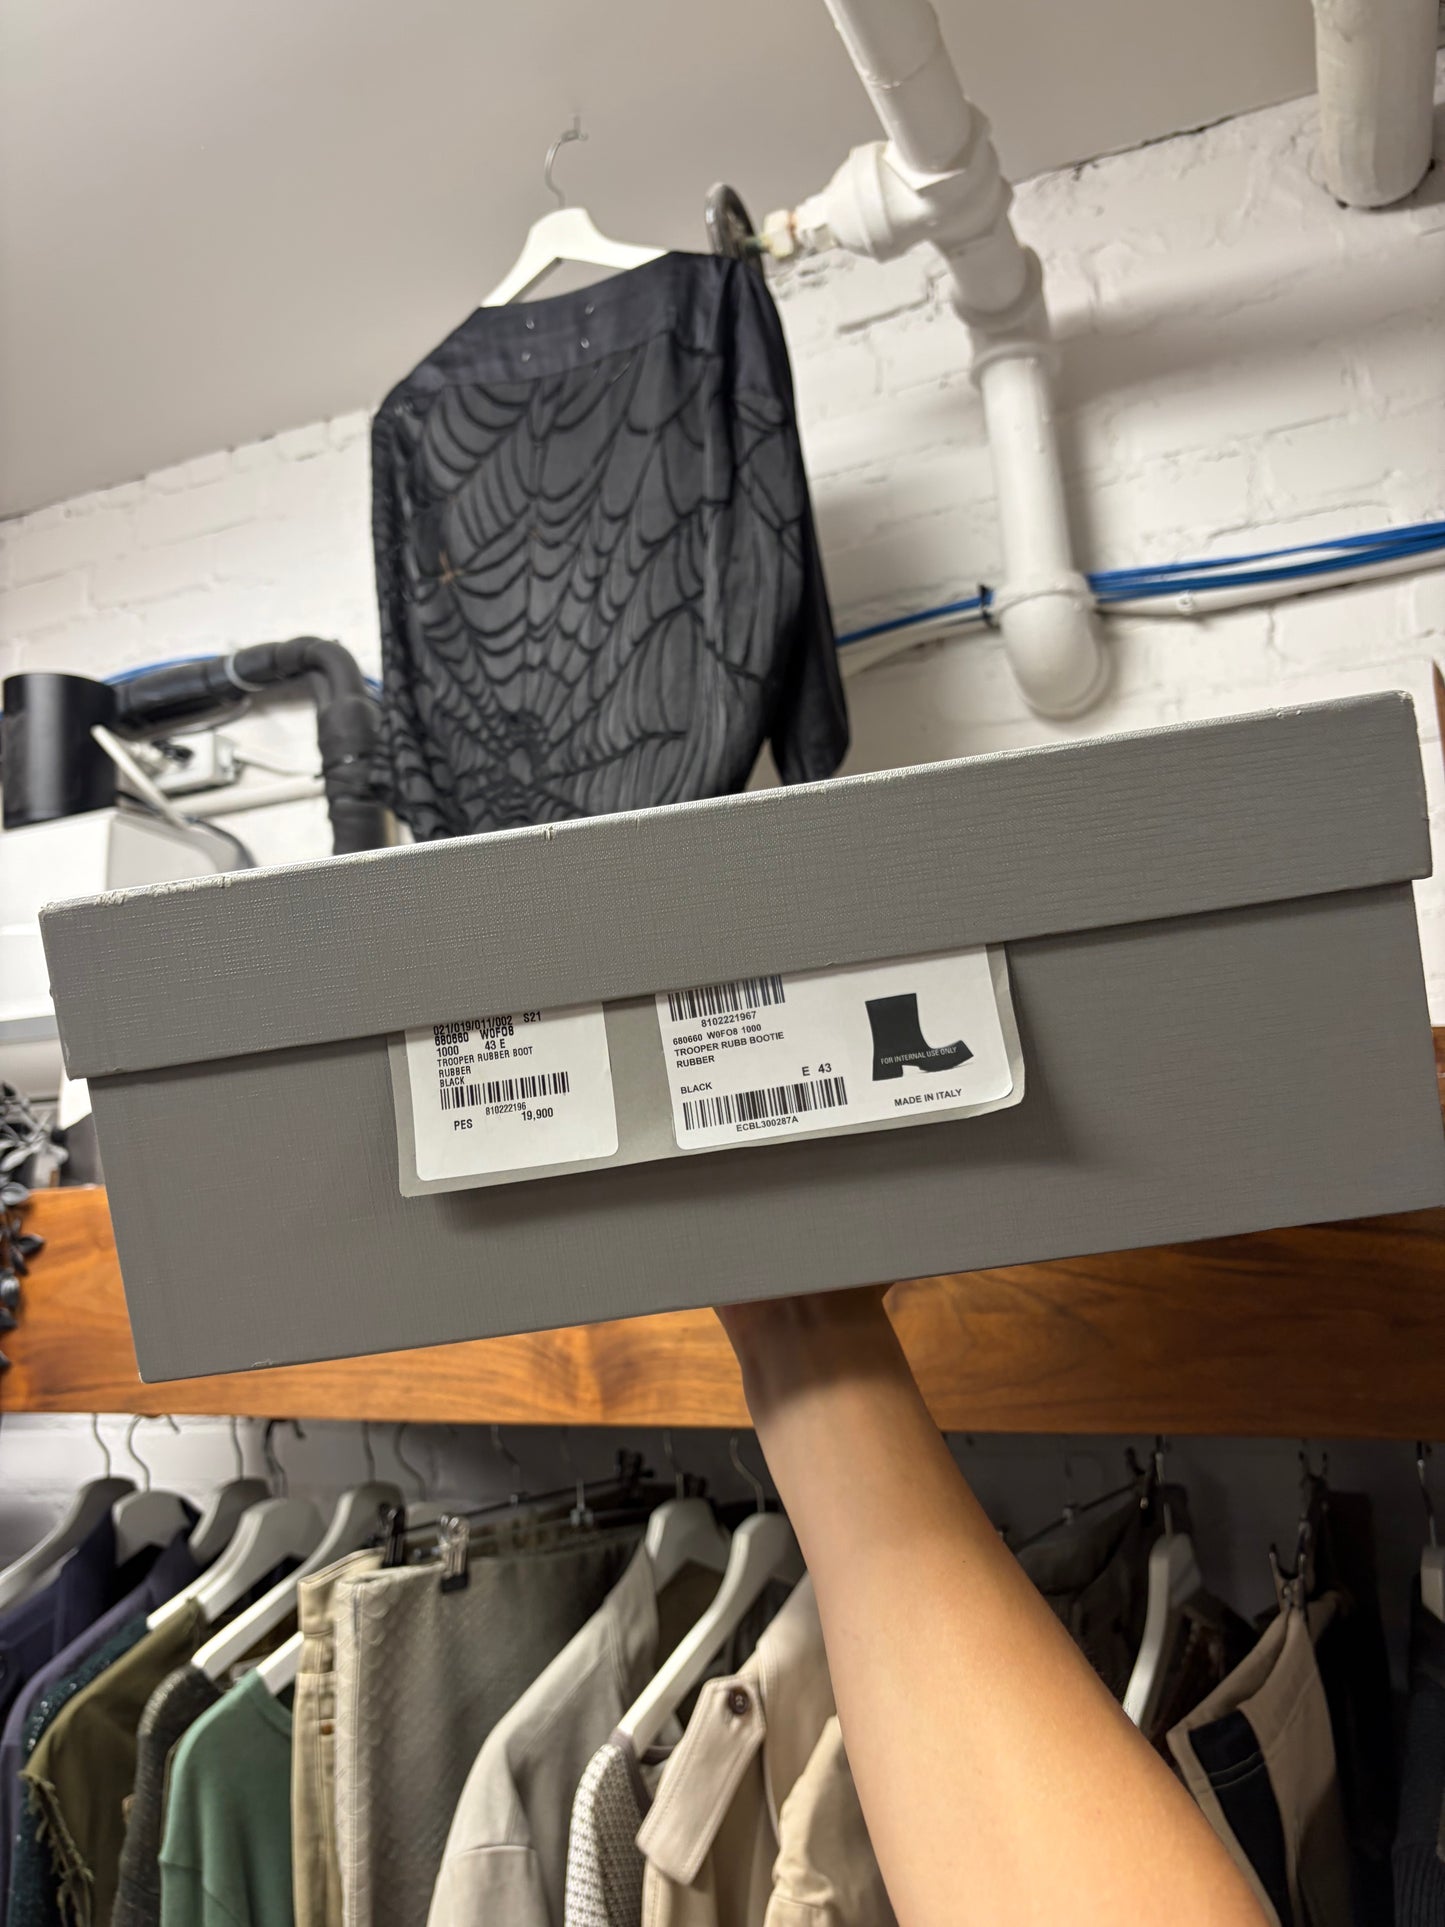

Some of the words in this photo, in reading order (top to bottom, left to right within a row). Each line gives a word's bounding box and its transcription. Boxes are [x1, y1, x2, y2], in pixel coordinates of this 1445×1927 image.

[523, 1011, 542, 1023] S21
[701, 1010, 757, 1028] 8102221967
[434, 1032, 469, 1046] 680660
[672, 1033, 703, 1046] 680660
[741, 1023, 762, 1034] 1000
[437, 1045, 459, 1058] 1000
[484, 1040, 497, 1051] 43
[499, 1038, 506, 1049] E
[674, 1042, 719, 1057] TROOPER
[721, 1037, 748, 1049] RUBB
[749, 1031, 785, 1044] BOOTIE
[437, 1055, 475, 1068] TROOPER
[477, 1050, 510, 1062] RUBBER
[512, 1046, 533, 1057] BOOT
[676, 1055, 715, 1068] RUBBER
[880, 1056, 894, 1065] FOR
[894, 1051, 926, 1062] INTERNAL
[926, 1049, 939, 1058] USE
[940, 1046, 958, 1056] ONLY
[438, 1065, 472, 1079] RUBBER
[801, 1066, 811, 1077] E
[818, 1062, 833, 1074] 43
[439, 1076, 465, 1088] BLACK
[680, 1082, 713, 1095] BLACK
[894, 1095, 922, 1107] MADE
[923, 1093, 934, 1103] IN
[935, 1088, 962, 1101] ITALY
[485, 1101, 527, 1116] 810222196
[453, 1118, 473, 1131] PES
[521, 1107, 554, 1122] 19,900
[736, 1116, 799, 1132] ECBL300287A
